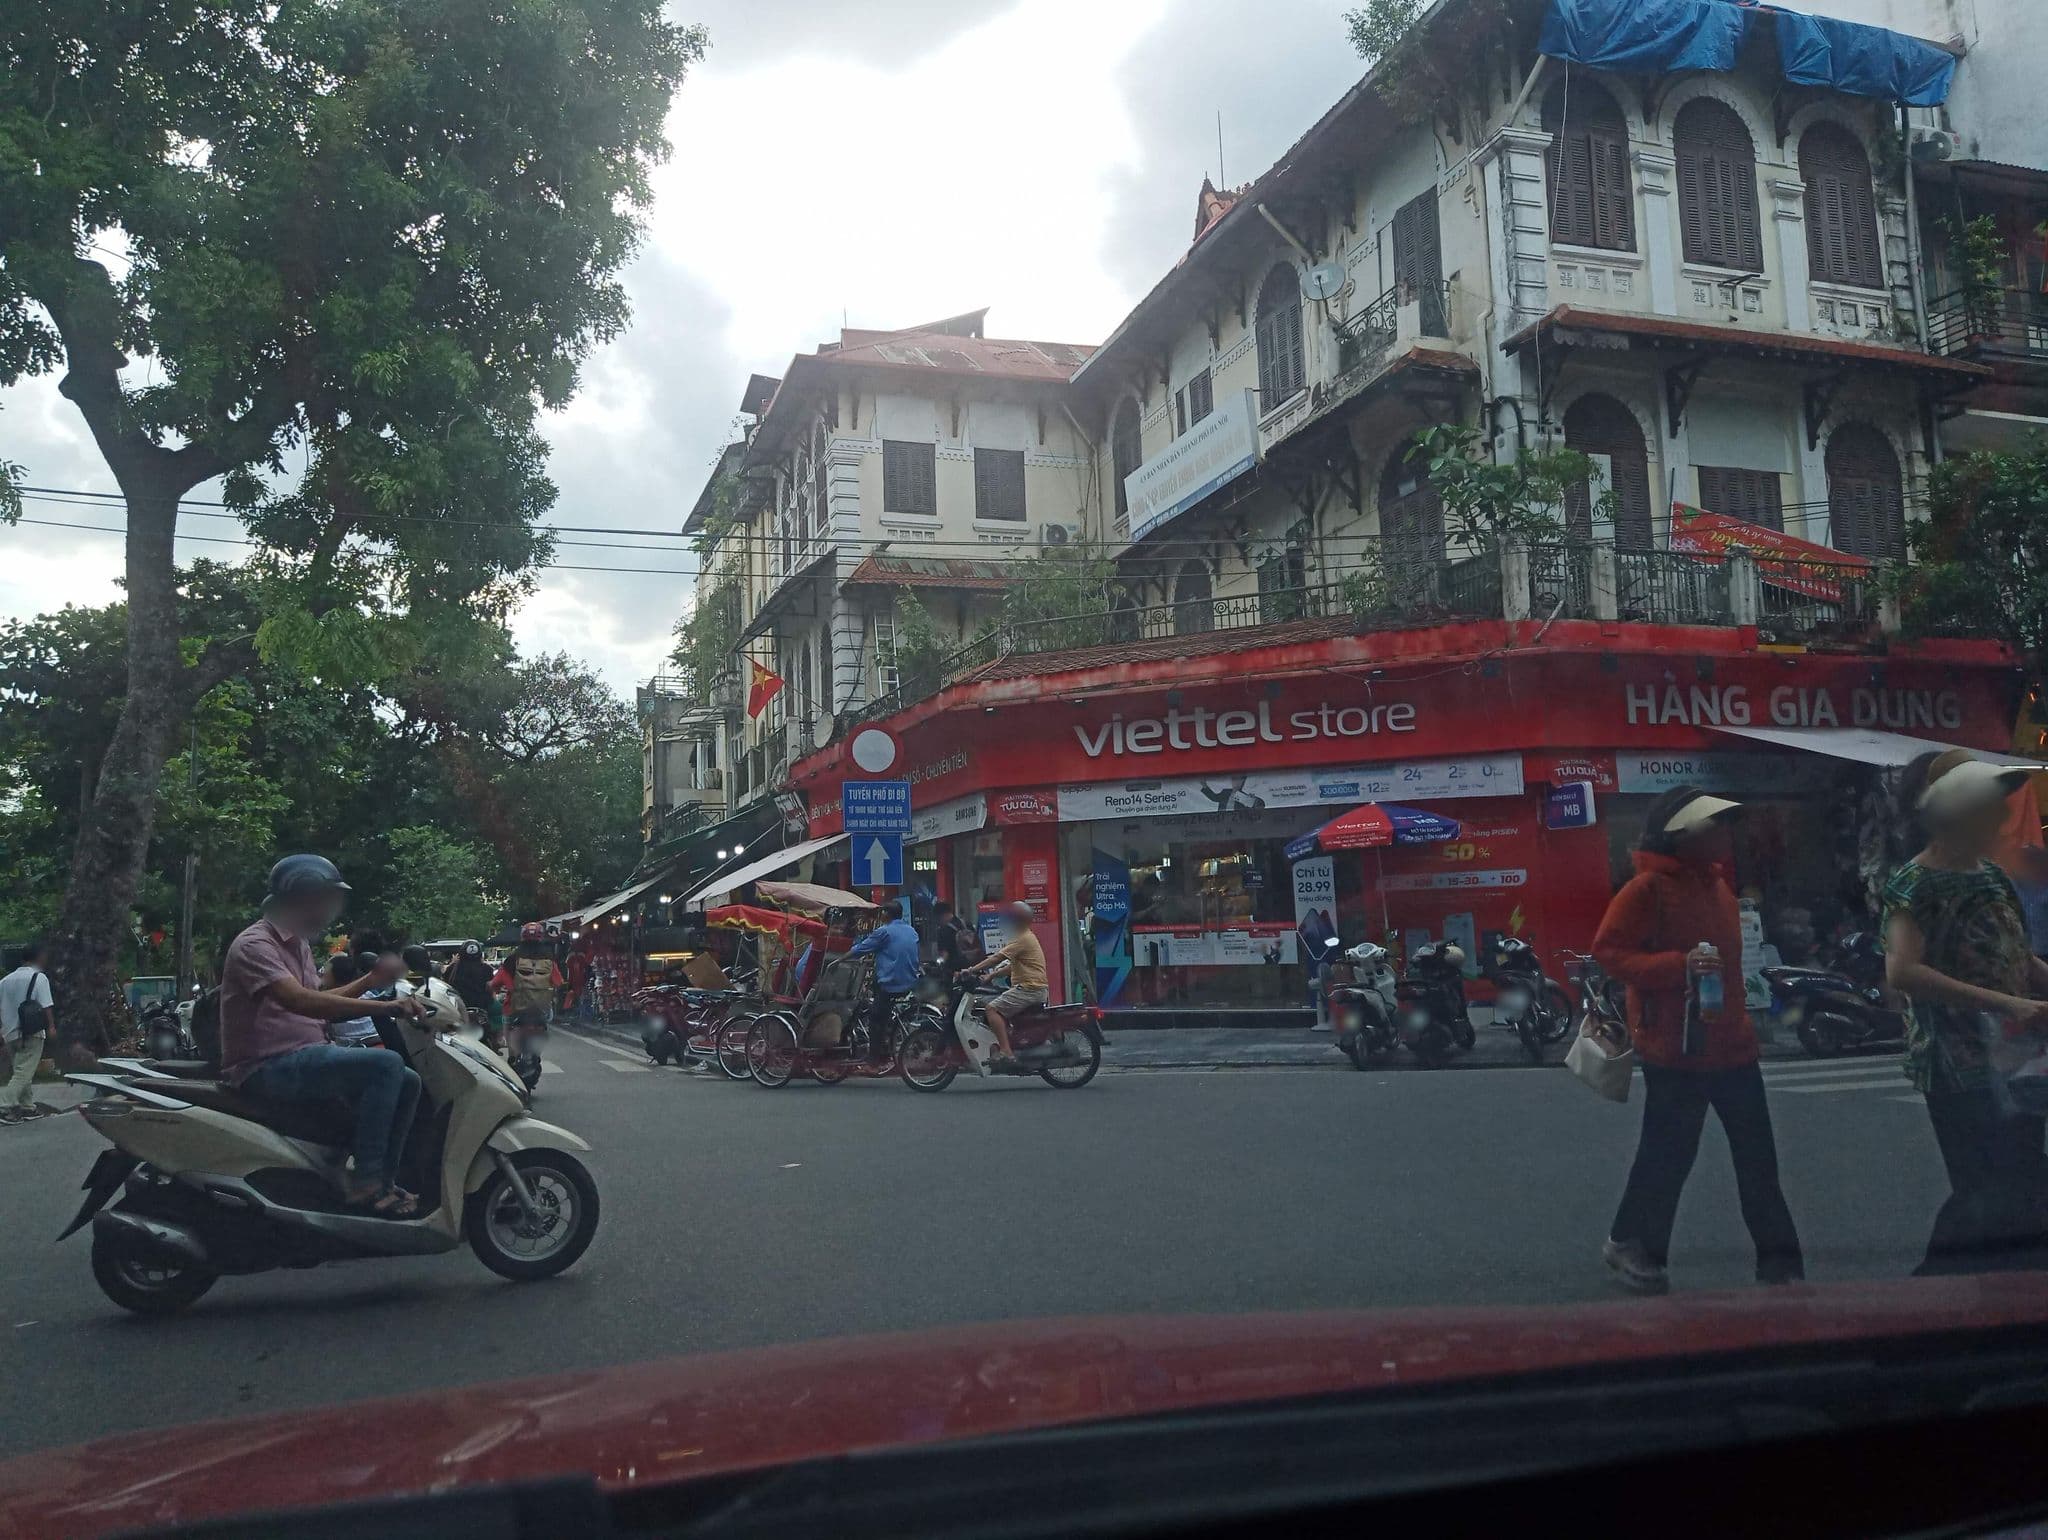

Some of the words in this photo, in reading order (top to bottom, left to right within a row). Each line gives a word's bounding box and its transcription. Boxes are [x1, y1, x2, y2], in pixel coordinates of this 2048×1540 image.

[1626, 668, 1751, 726] HÀNG
[1769, 686, 1839, 728] GIA
[1072, 701, 1283, 757] viettel
[1290, 703, 1416, 740] store
[1403, 768, 1422, 781] 24
[1448, 766, 1458, 778] 2
[1640, 760, 1693, 774] HONOR
[1368, 782, 1380, 793] 12
[1105, 794, 1142, 807] Reno14
[1144, 792, 1177, 805] Series
[955, 805, 977, 822] SAMSUNG
[1564, 804, 1580, 817] MB
[1317, 866, 1330, 878] từ
[1096, 882, 1125, 892] nghiệm
[1298, 881, 1331, 893] 28.99
[1448, 876, 1480, 886] 15-30
[1500, 875, 1520, 884] 100
[1096, 900, 1113, 912] Gập
